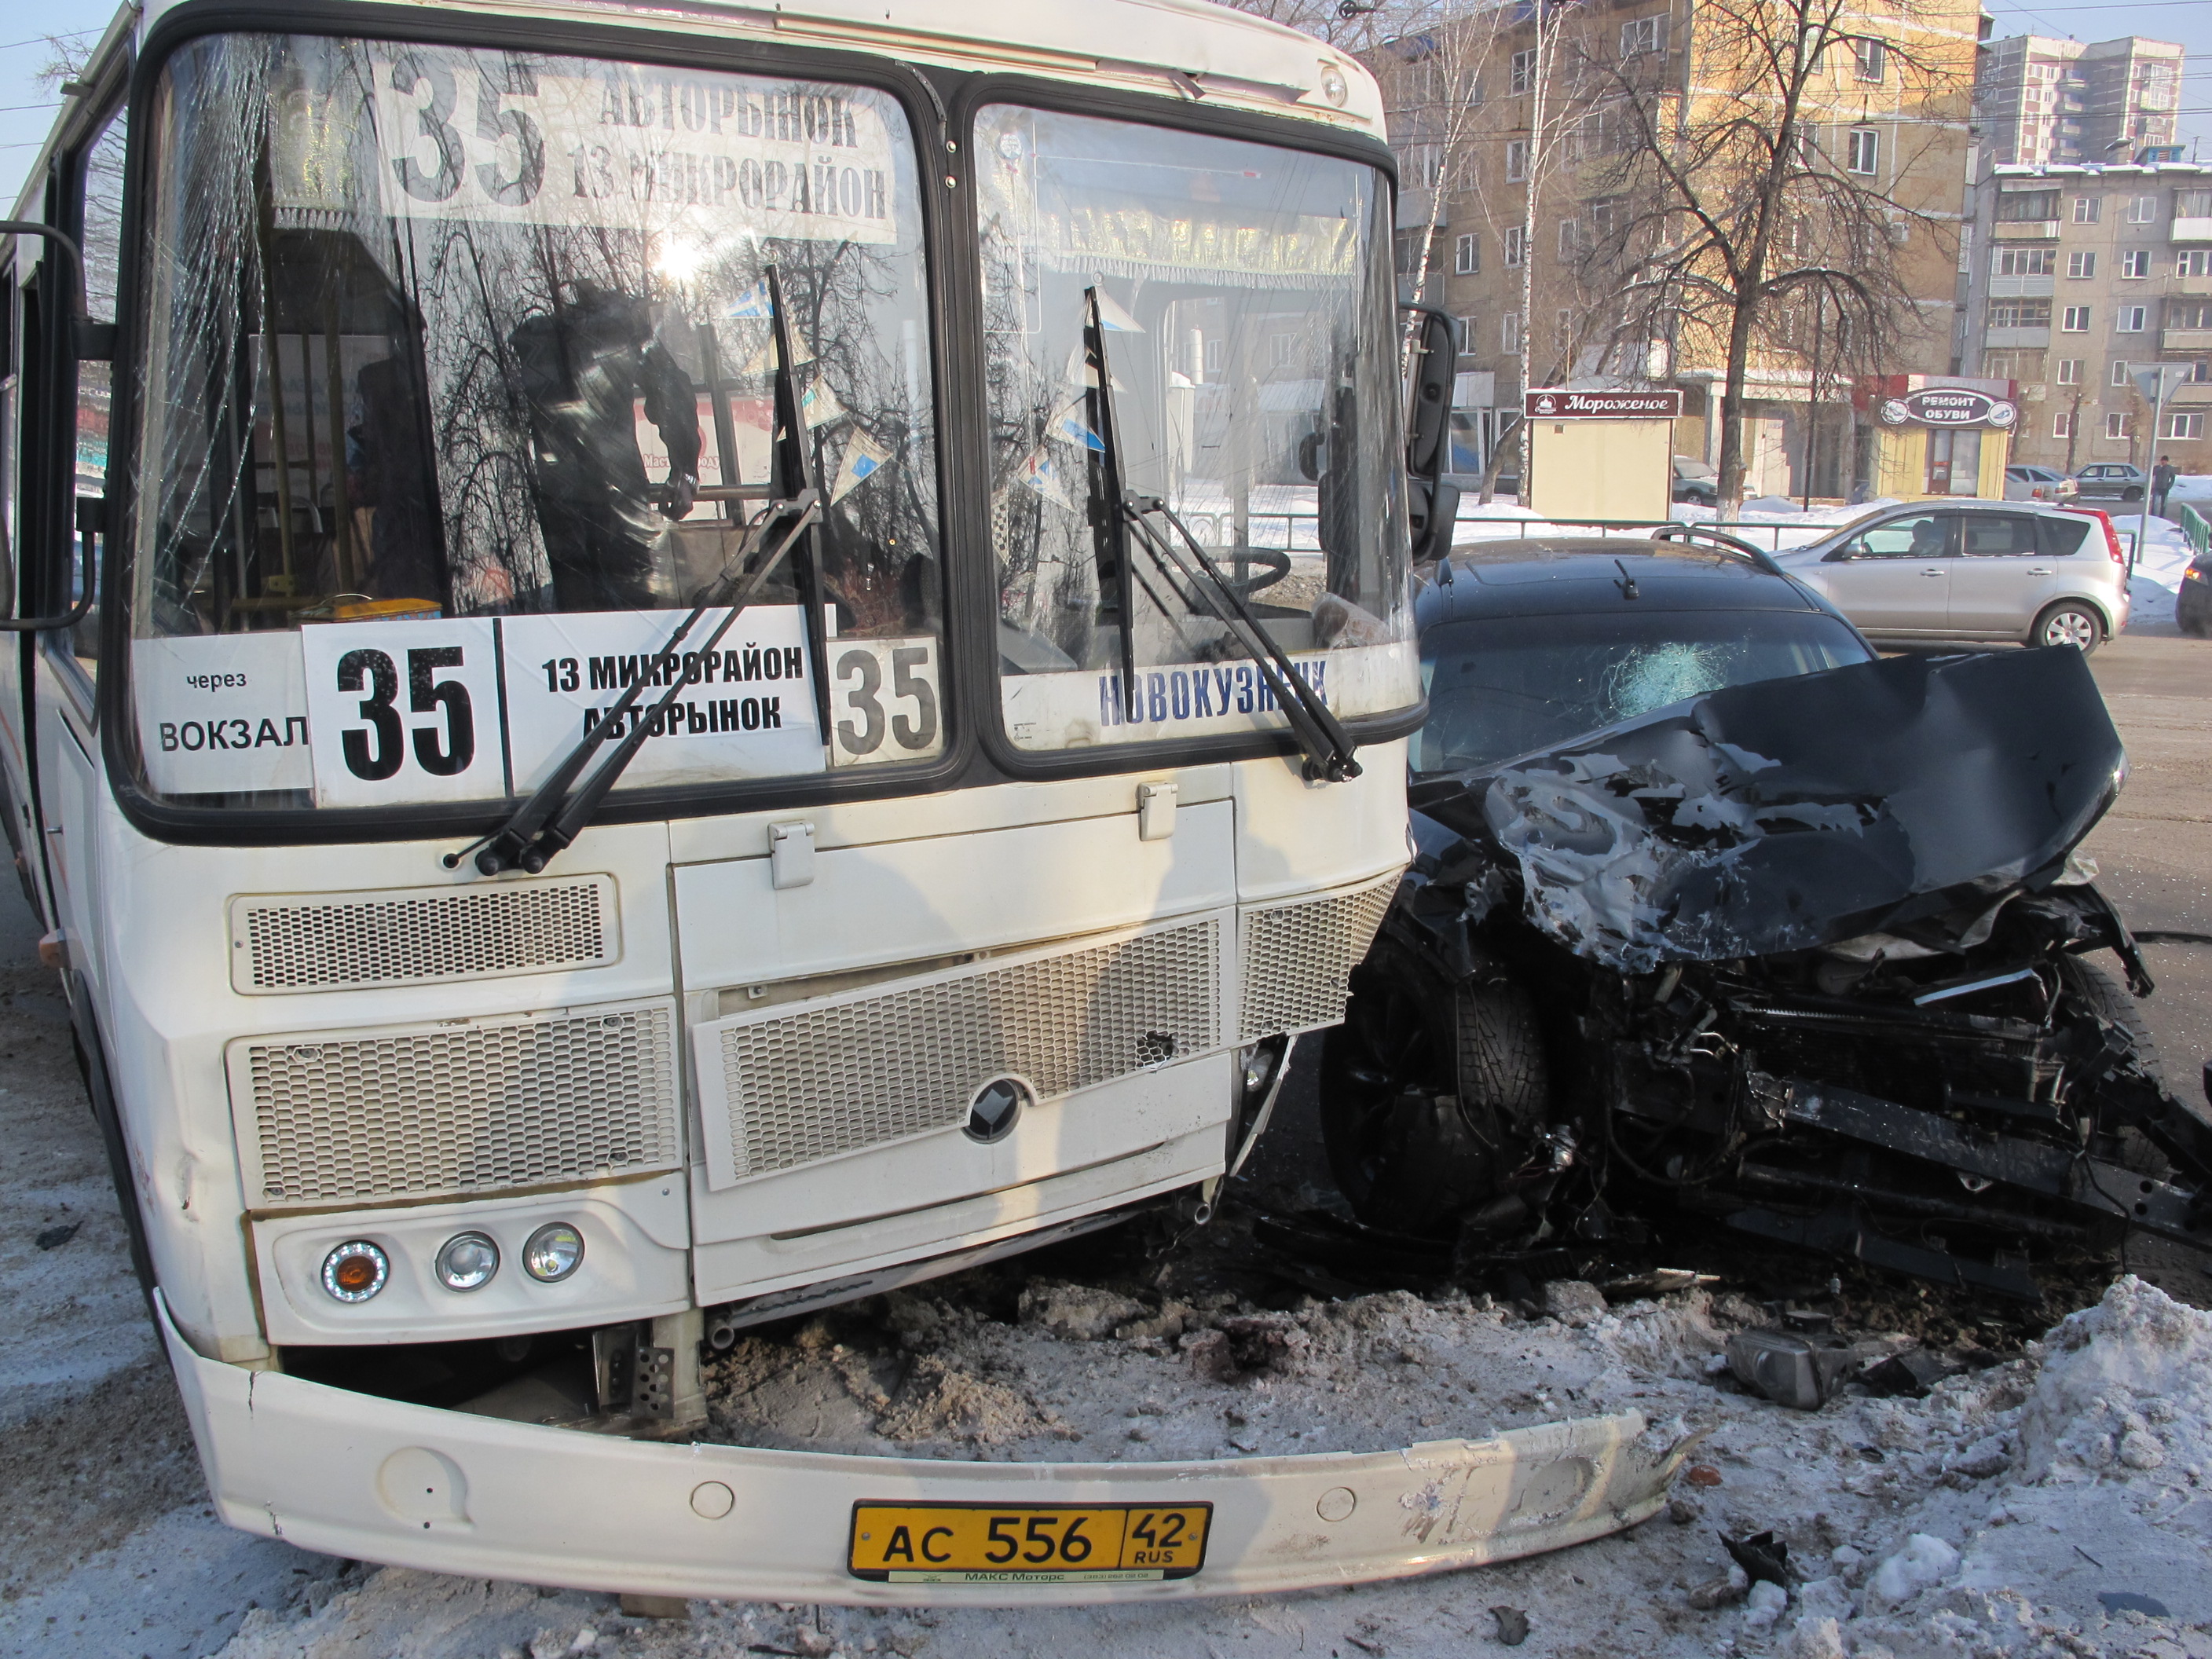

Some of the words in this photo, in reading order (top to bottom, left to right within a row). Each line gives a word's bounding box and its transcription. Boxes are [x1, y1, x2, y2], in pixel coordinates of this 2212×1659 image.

[391, 53, 546, 207] 35
[599, 77, 859, 148] АВТОРЫНОК
[567, 145, 615, 199] 13
[630, 149, 886, 220] МИКРОРАЙОН
[1564, 395, 1670, 414] Мороженое
[1921, 396, 1977, 407] РЕМОНТ
[1925, 408, 1971, 420] ОБУВИ
[186, 671, 247, 693] через
[542, 657, 580, 693] 13
[589, 642, 804, 690] МИКРОРАЙОН
[337, 646, 475, 782] 35
[583, 697, 782, 741] АВТОРЫНОК
[836, 647, 938, 756] 35
[159, 716, 309, 752] ВОКЗАЛ
[984, 1516, 1093, 1563] 556
[1131, 1513, 1187, 1548] 42
[1134, 1550, 1174, 1564] RUS
[1012, 1573, 1065, 1582] Моторс
